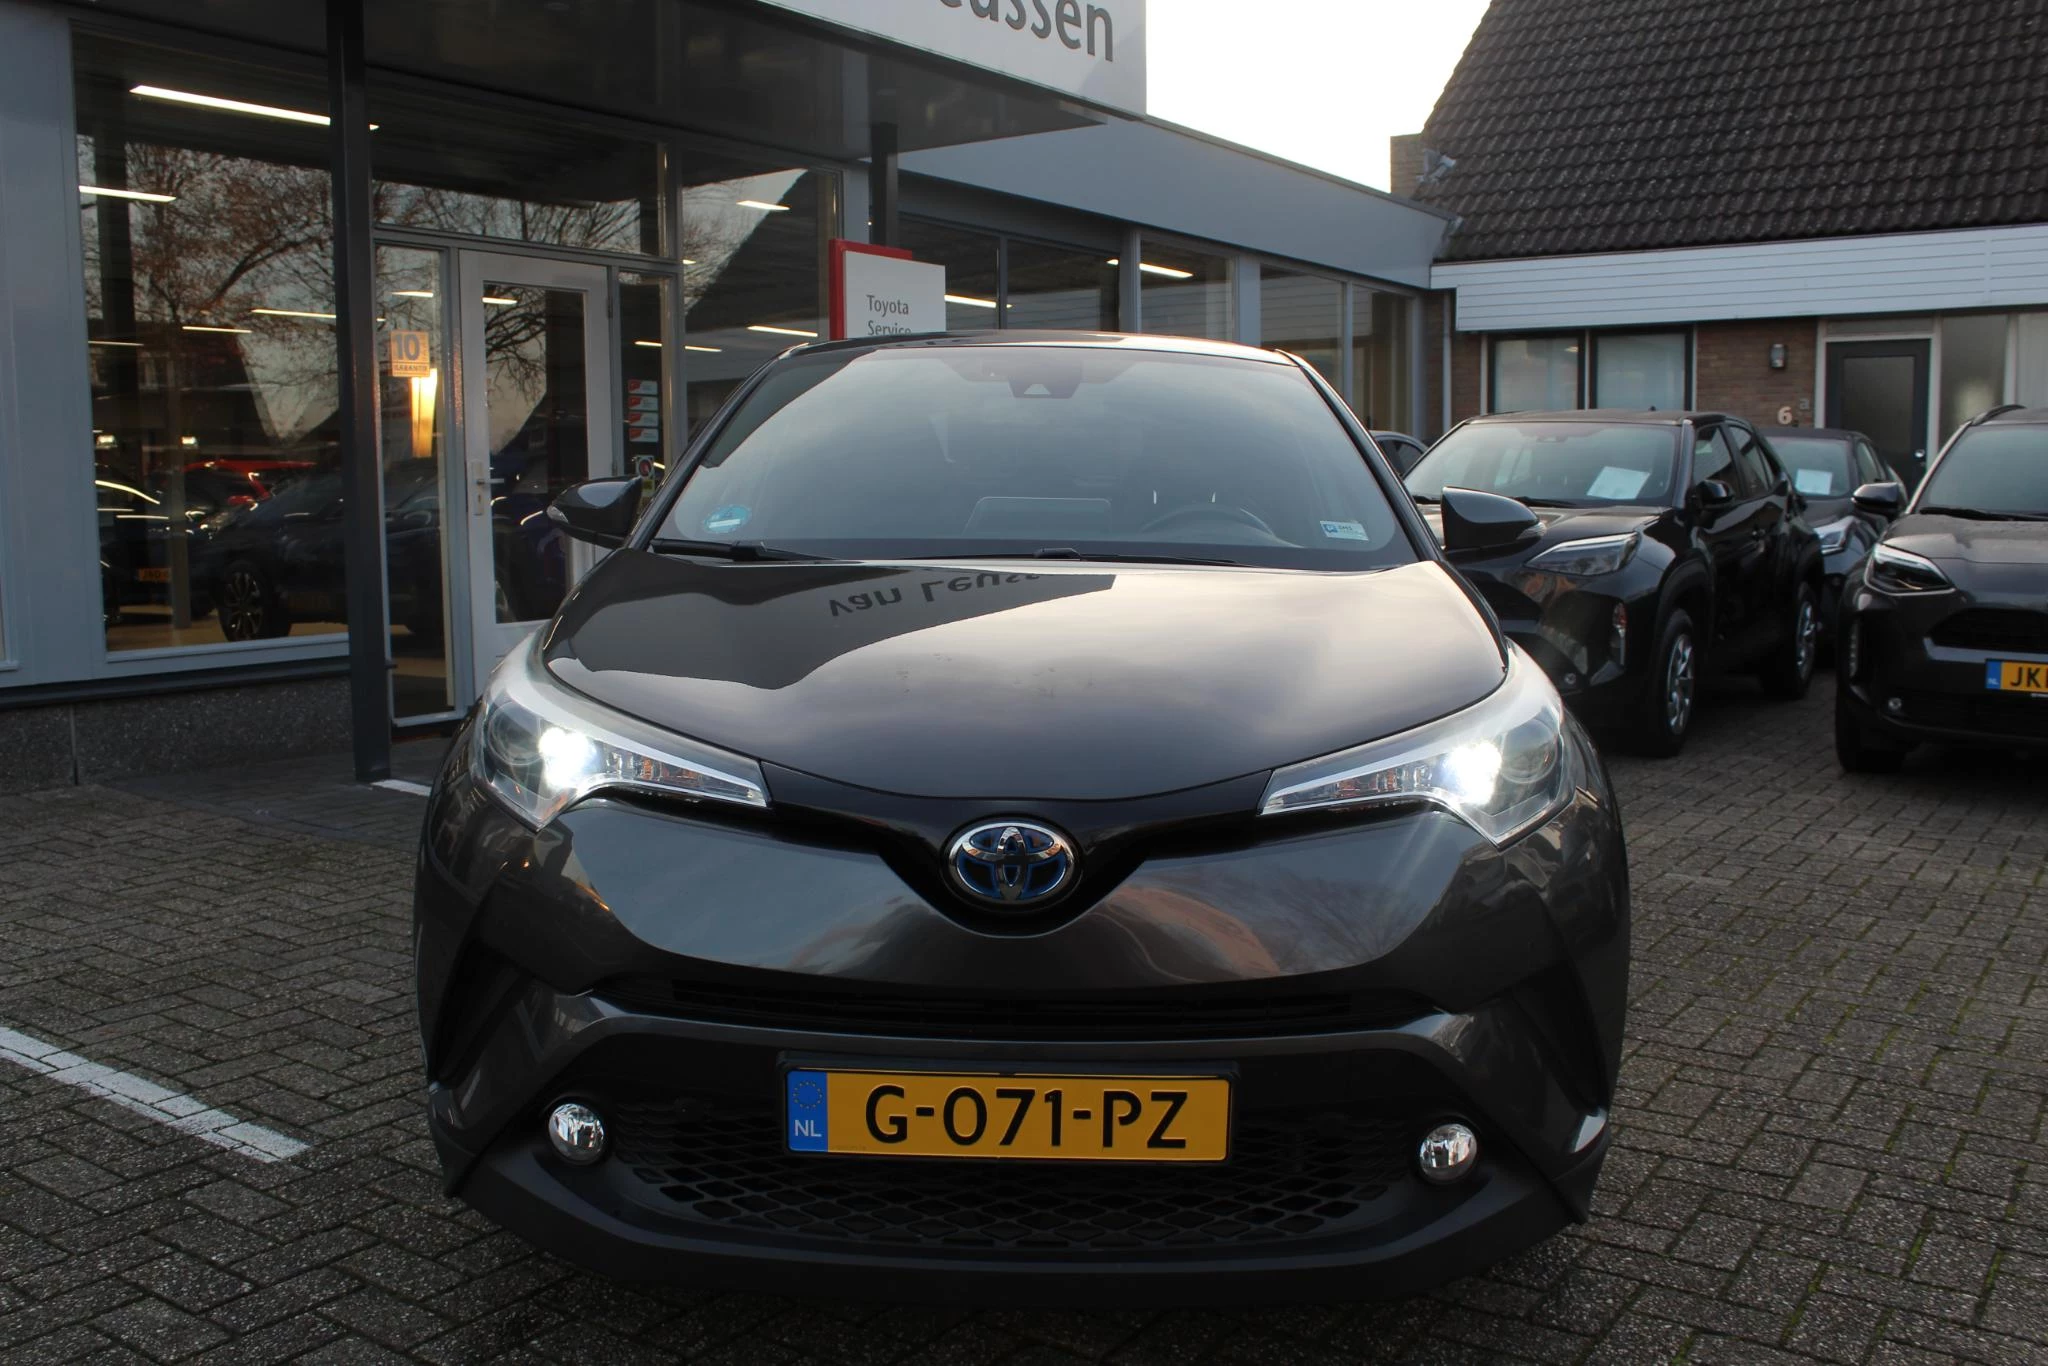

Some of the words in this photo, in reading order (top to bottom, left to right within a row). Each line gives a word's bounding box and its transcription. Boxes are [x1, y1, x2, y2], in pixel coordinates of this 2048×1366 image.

[866, 294, 909, 317] Toyota
[396, 334, 420, 361] 10
[1778, 406, 1792, 424] 6
[2010, 666, 2048, 688] JK
[865, 1084, 1188, 1149] G-071-PZ
[794, 1120, 822, 1138] NL
